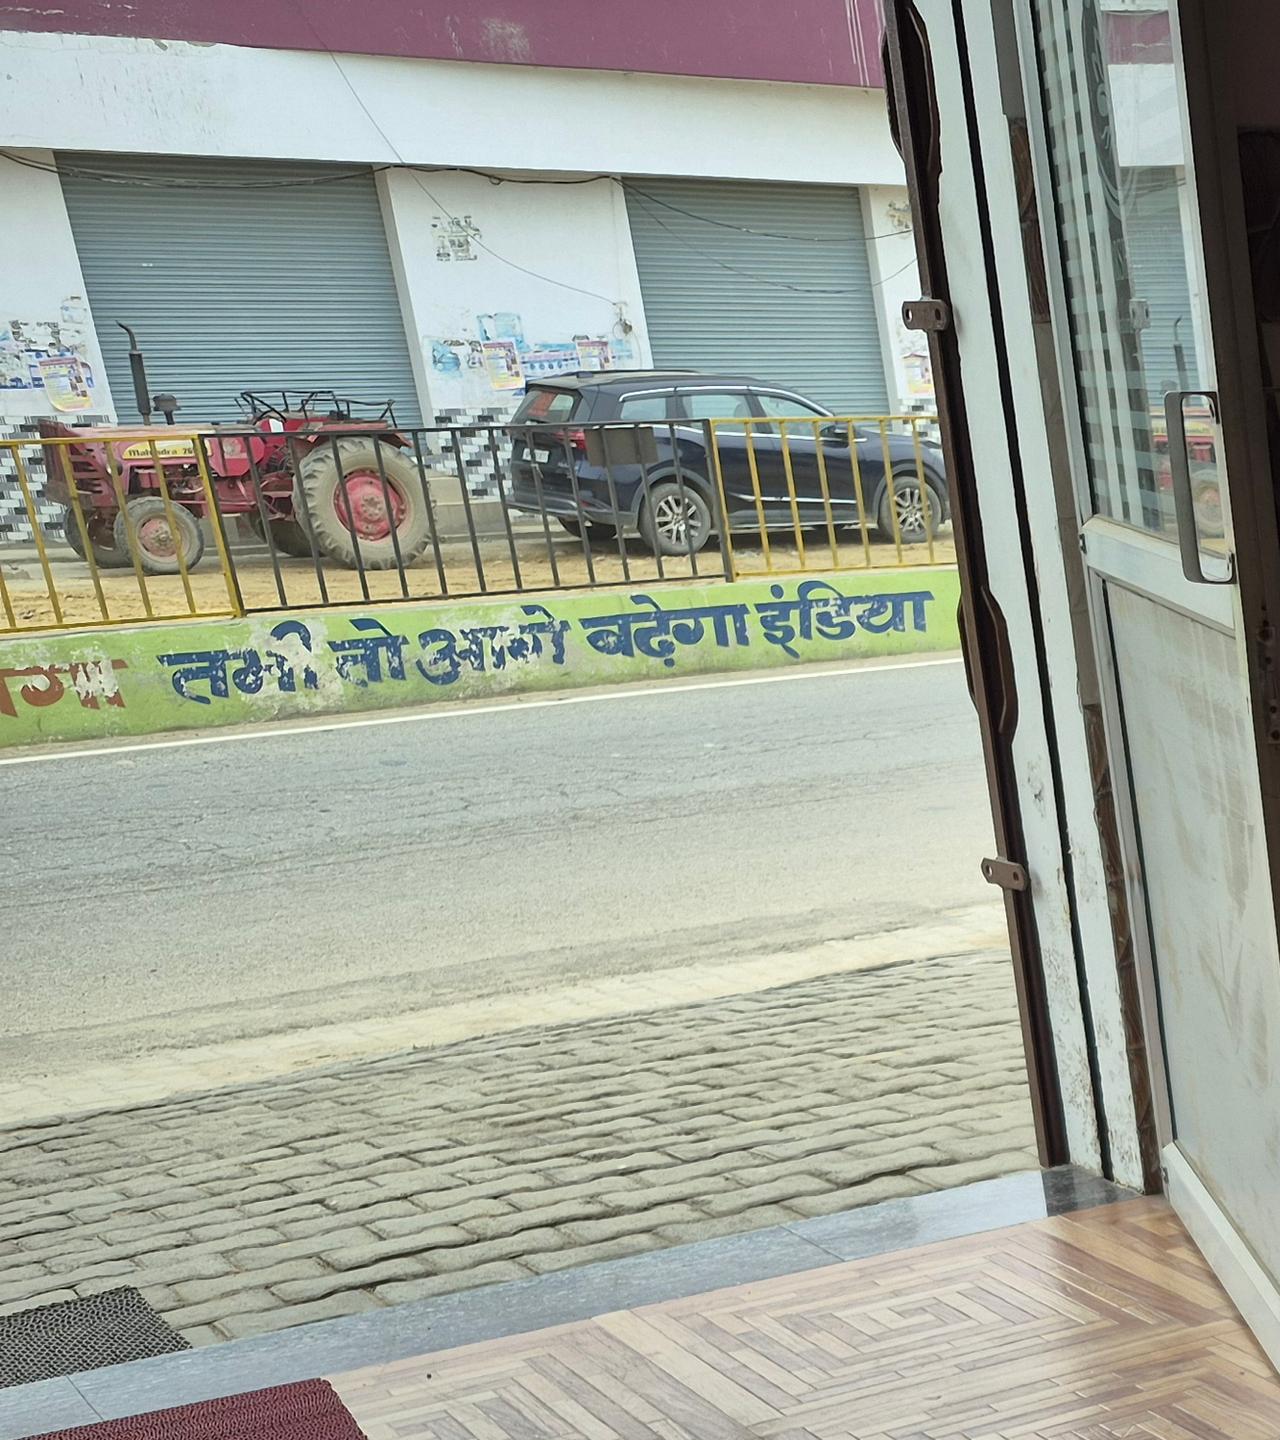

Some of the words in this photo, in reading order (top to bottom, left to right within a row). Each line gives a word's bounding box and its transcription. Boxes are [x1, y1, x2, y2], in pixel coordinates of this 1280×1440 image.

[0, 659, 128, 717] गा
[327, 617, 410, 688] तो
[416, 603, 571, 686] आगे
[579, 595, 752, 668] बढ़ेगा
[753, 580, 935, 660] इंडिया
